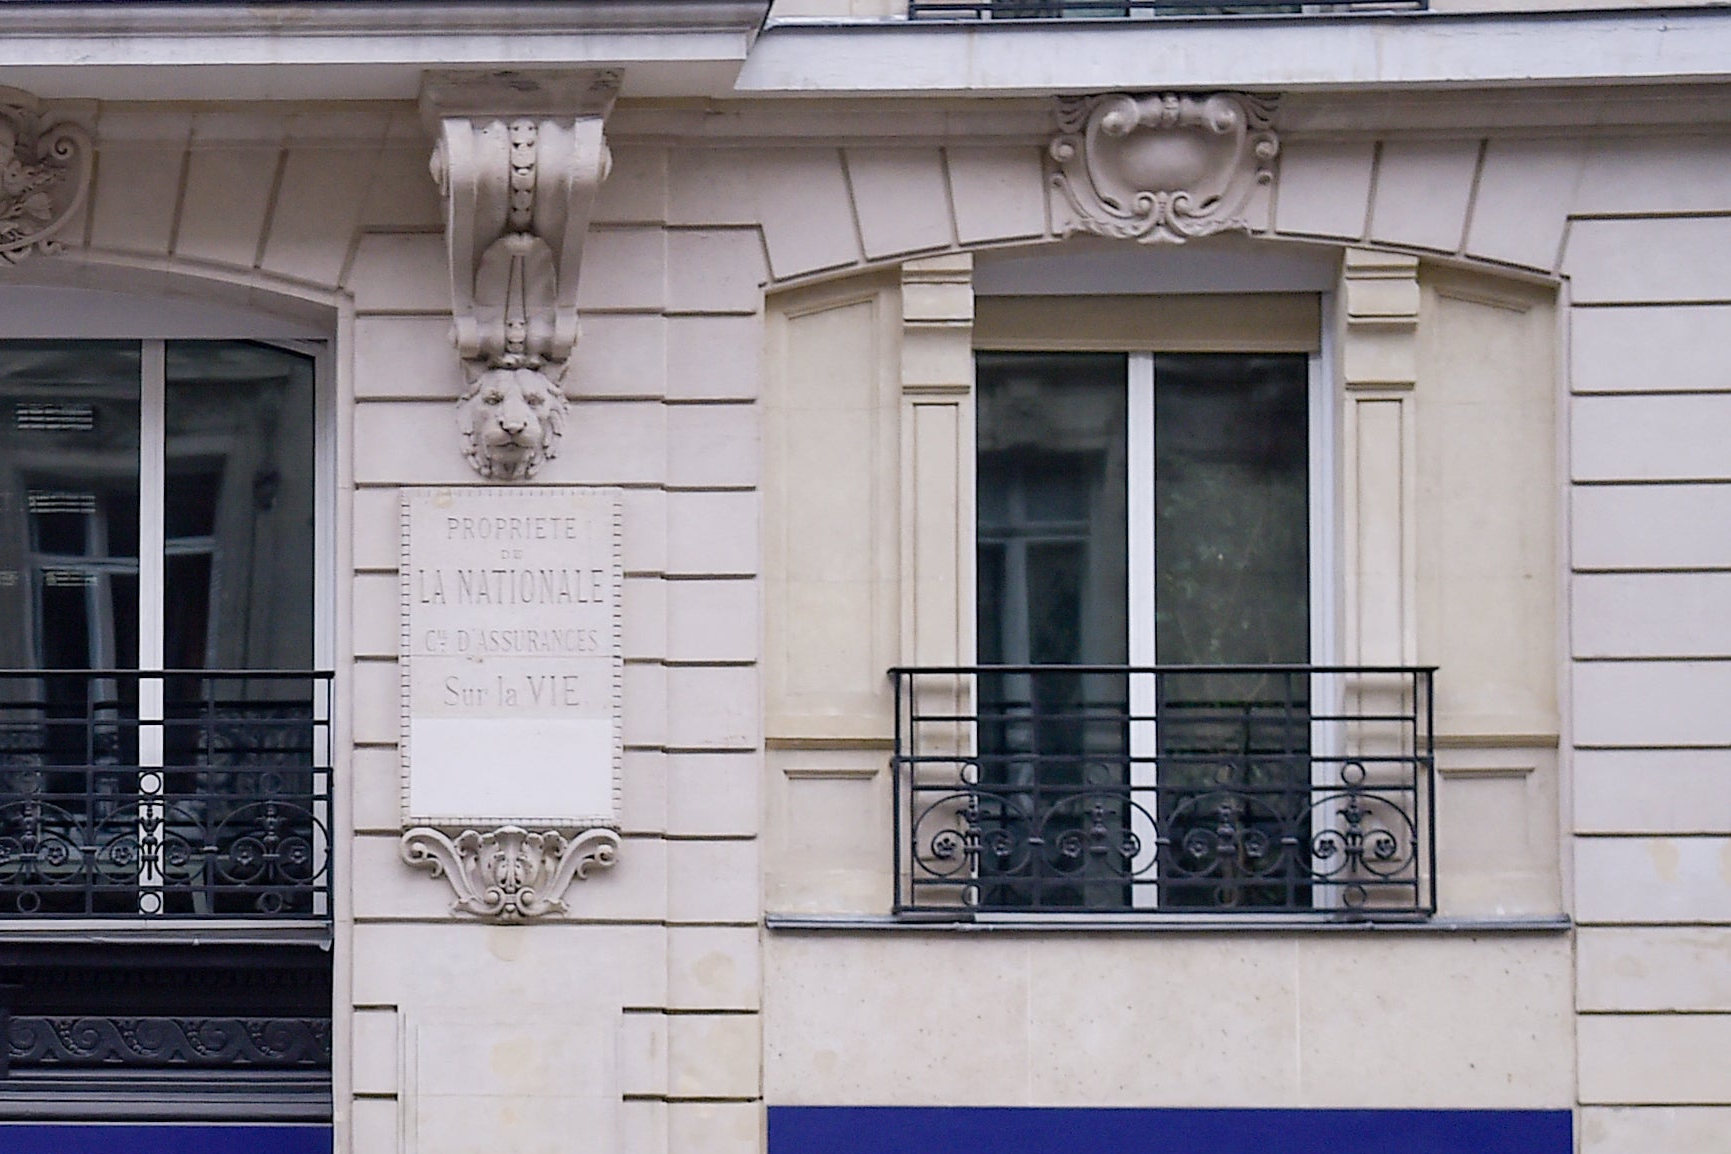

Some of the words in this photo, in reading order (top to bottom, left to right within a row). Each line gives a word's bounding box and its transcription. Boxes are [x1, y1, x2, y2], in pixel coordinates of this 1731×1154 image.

[501, 549, 523, 560] DE
[418, 569, 445, 604] LA
[457, 569, 604, 604] NATIONALE
[457, 629, 599, 652] D'ASSURANCES
[444, 675, 488, 707] Sur
[498, 675, 520, 707] la
[526, 675, 581, 707] VIE
